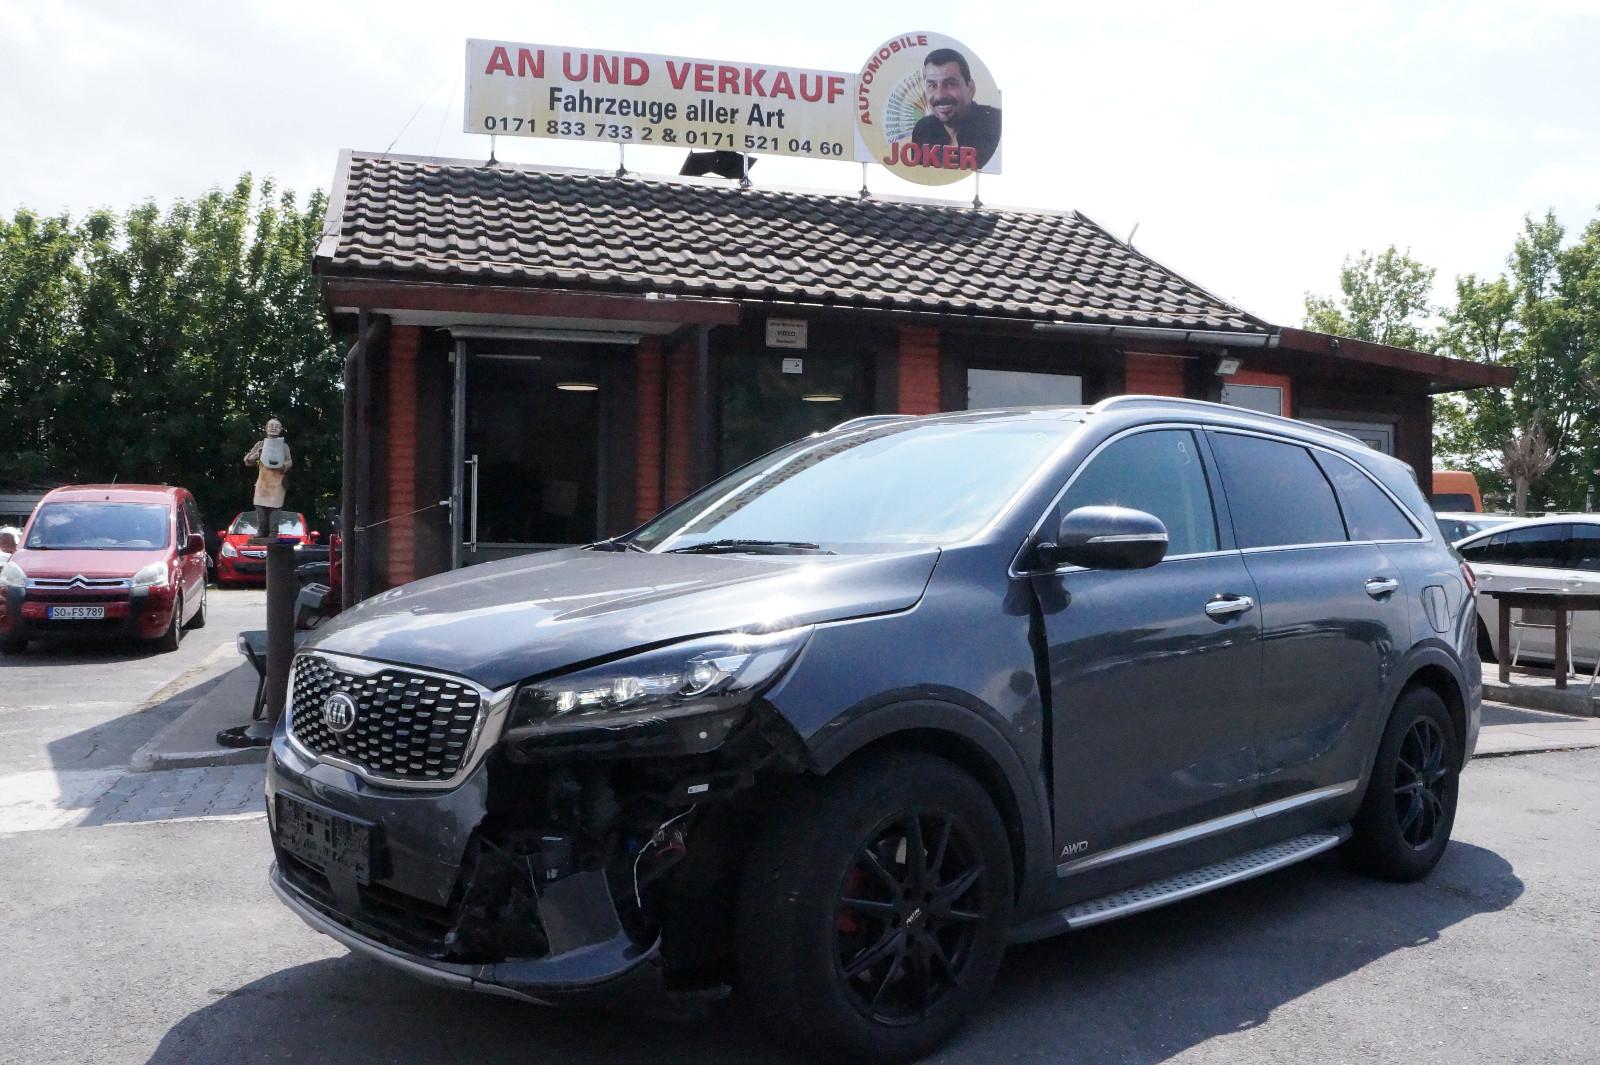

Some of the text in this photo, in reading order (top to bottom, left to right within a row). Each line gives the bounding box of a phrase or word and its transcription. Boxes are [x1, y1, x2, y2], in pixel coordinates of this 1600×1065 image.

[485, 46, 845, 103] AN UND VERKAUF
[859, 35, 928, 125] AUTOMOBILE
[549, 87, 785, 129] Fahrzeuge aller Art
[484, 116, 843, 156] 0171 833 733 2 & 0171 521 04 60
[883, 142, 977, 171] JOKER
[86, 607, 103, 617] 789
[1060, 840, 1089, 857] AWD
